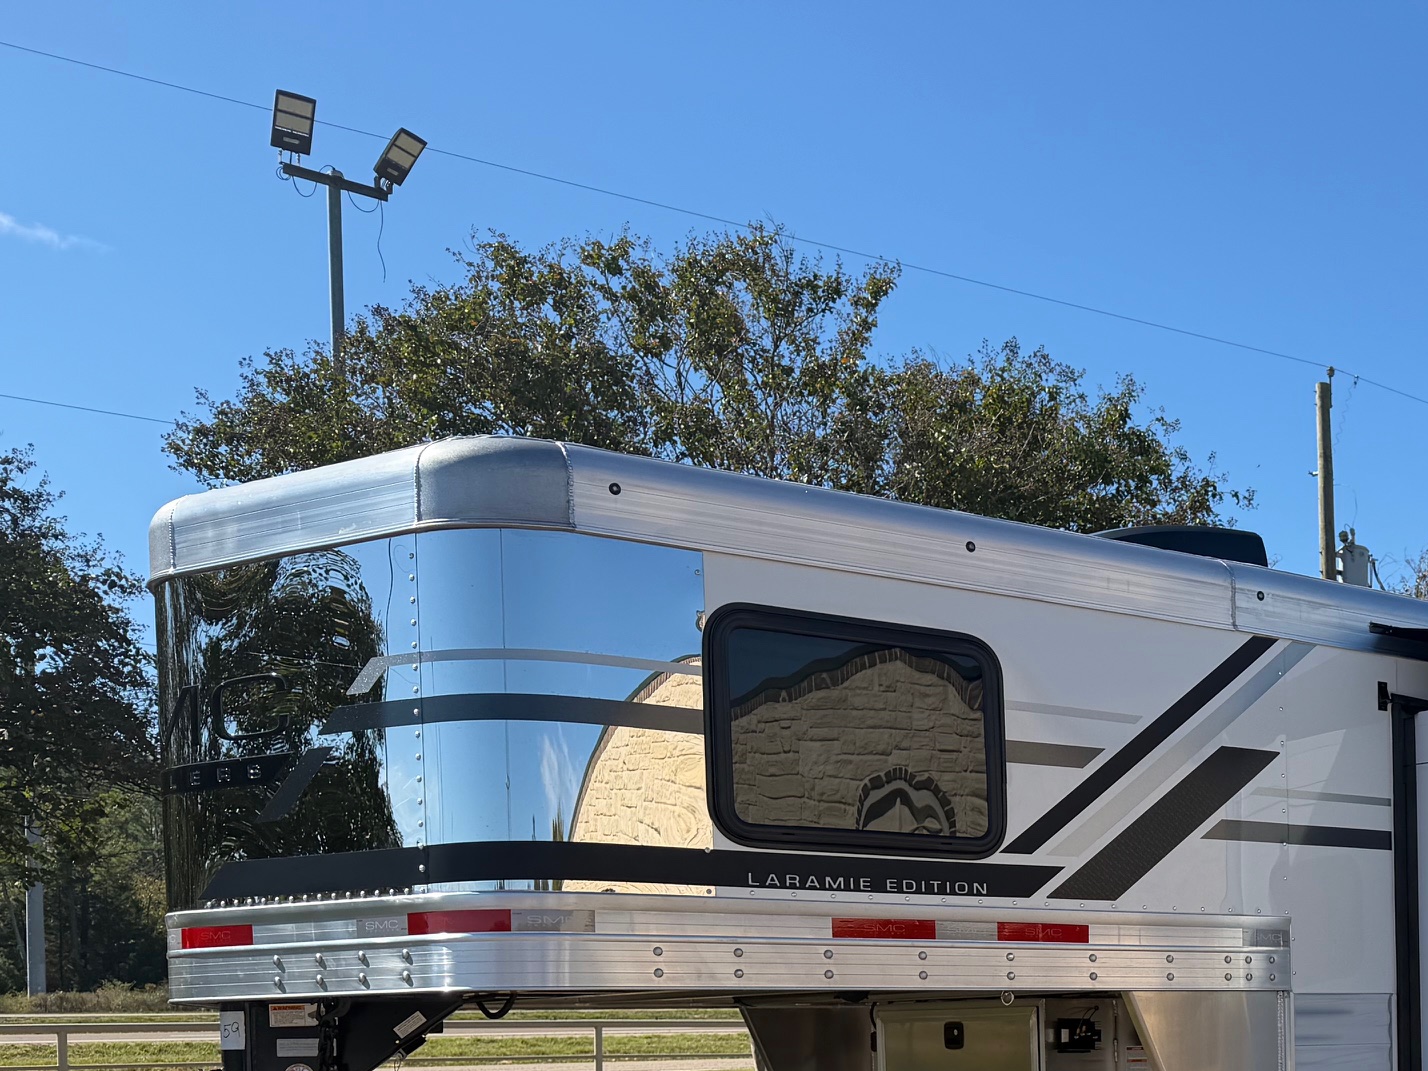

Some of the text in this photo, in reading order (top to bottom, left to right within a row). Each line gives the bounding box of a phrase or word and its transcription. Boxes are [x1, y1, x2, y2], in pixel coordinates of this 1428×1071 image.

[748, 872, 988, 895] LARAMIE EDITION
[365, 919, 399, 931] SMC
[863, 923, 906, 933] SMC
[200, 930, 231, 941] SMC
